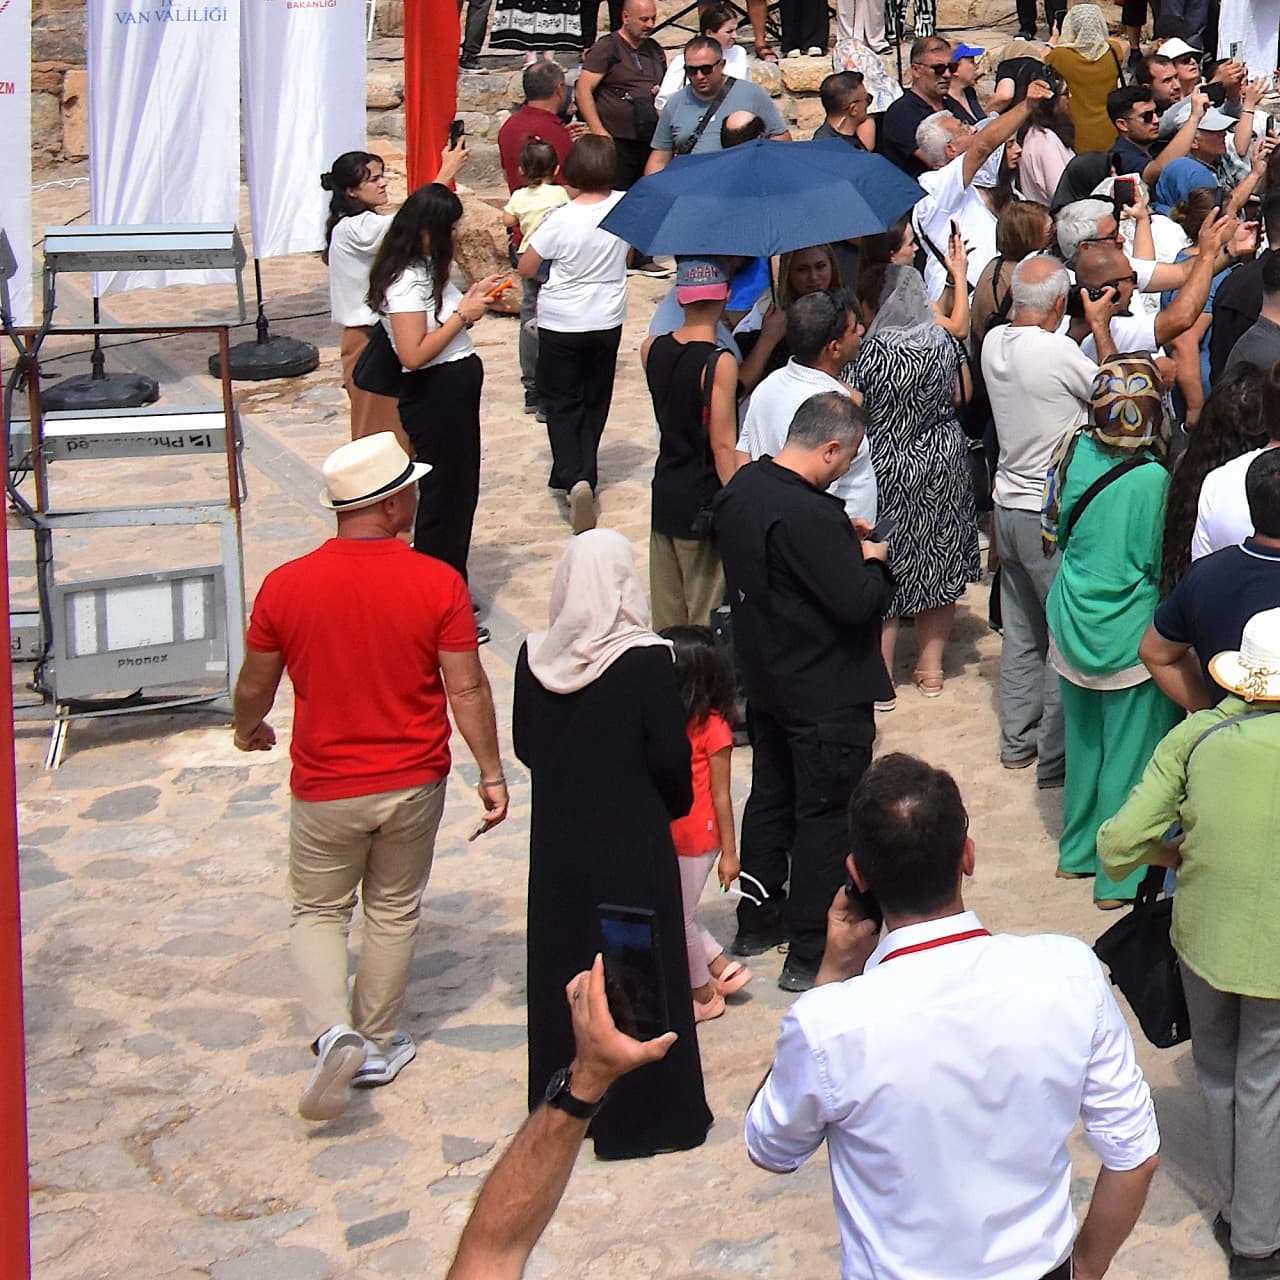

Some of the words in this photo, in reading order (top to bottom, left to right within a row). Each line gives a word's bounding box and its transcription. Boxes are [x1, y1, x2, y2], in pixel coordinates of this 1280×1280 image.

[286, 0, 337, 9] BAKANLIĞI
[115, 11, 150, 25] VAN
[155, 6, 228, 23] VALİLİĞİ
[117, 653, 168, 669] Phonex
